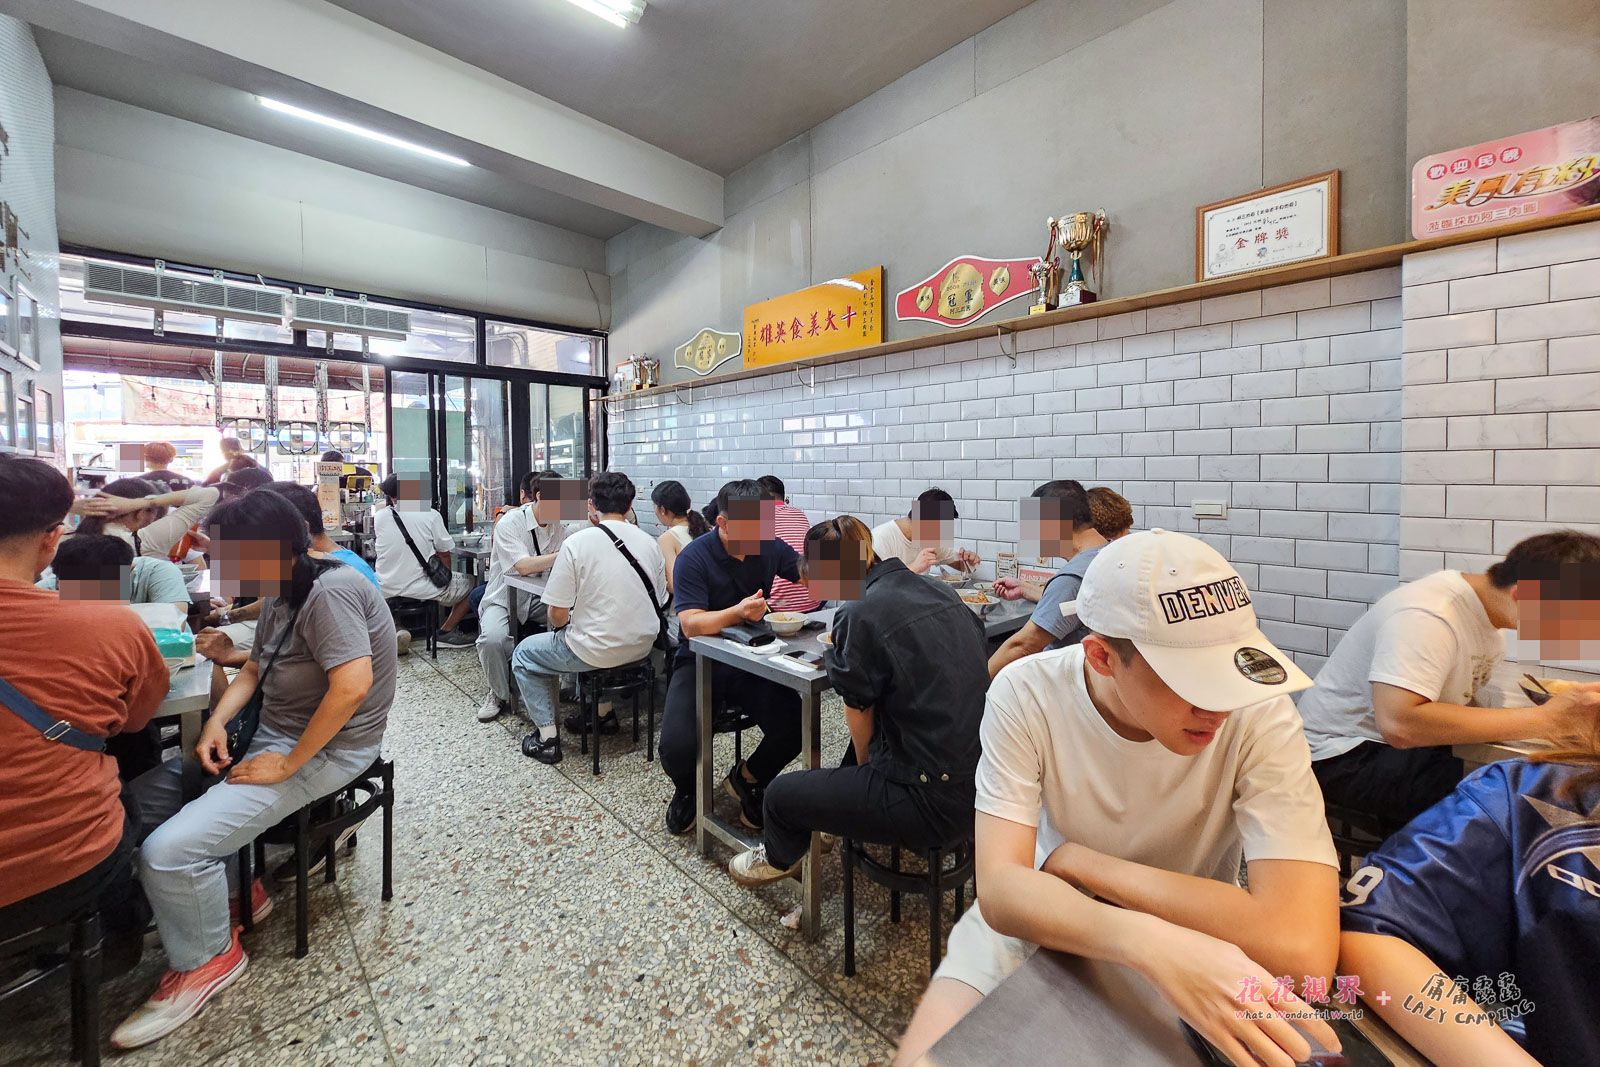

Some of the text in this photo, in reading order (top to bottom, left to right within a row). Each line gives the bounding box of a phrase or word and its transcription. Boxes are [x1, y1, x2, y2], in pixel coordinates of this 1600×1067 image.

[1429, 148, 1521, 179] 歡迎民視
[1235, 226, 1289, 250] 金牌獎
[948, 289, 973, 308] 冠軍
